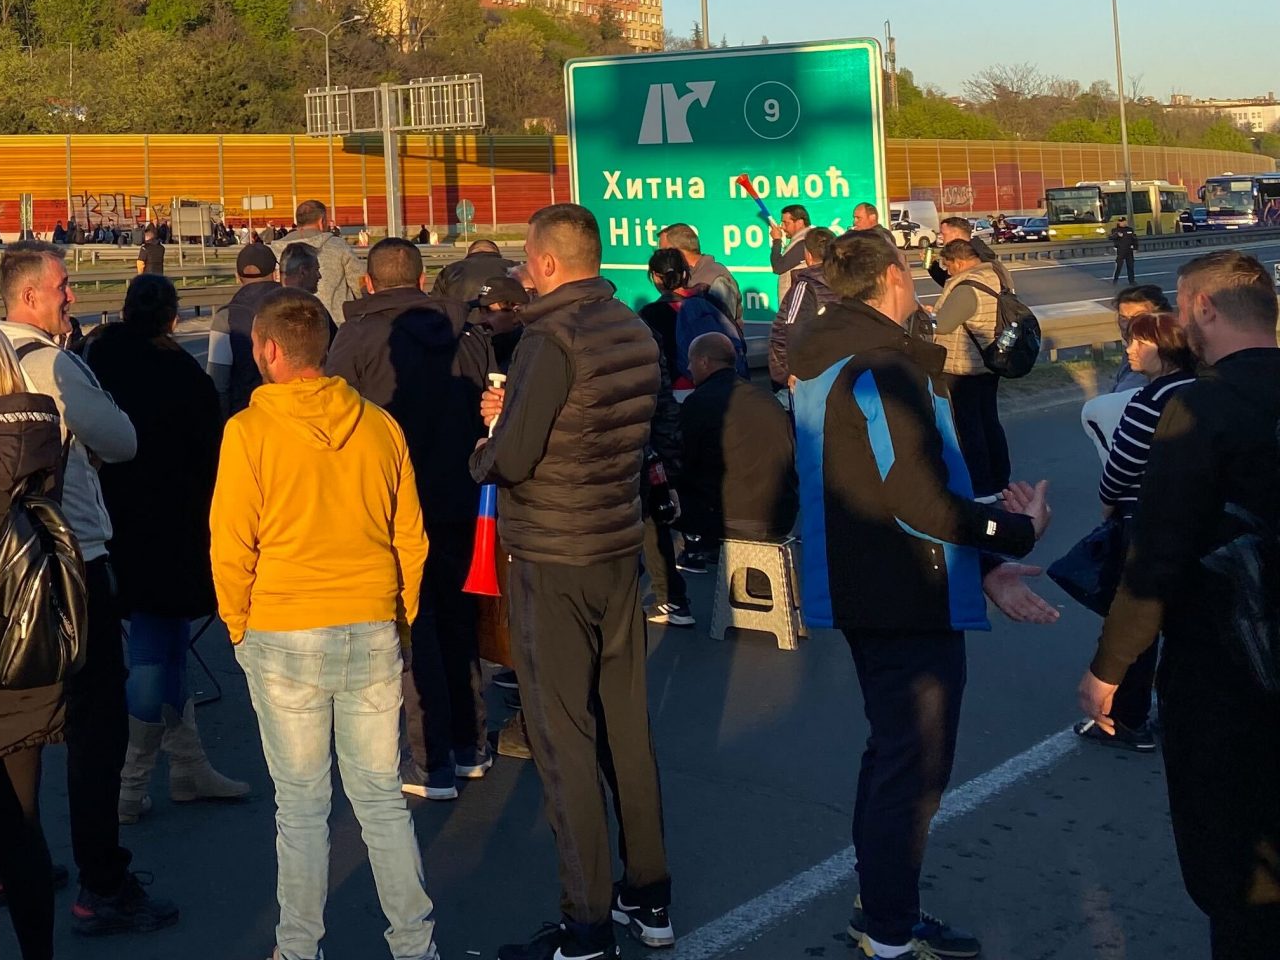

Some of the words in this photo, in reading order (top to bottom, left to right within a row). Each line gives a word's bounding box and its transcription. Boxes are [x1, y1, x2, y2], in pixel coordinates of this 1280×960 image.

[763, 98, 780, 122] 9
[602, 170, 705, 200] Хитна
[729, 166, 851, 199] помоћ
[609, 217, 699, 247] Hit
